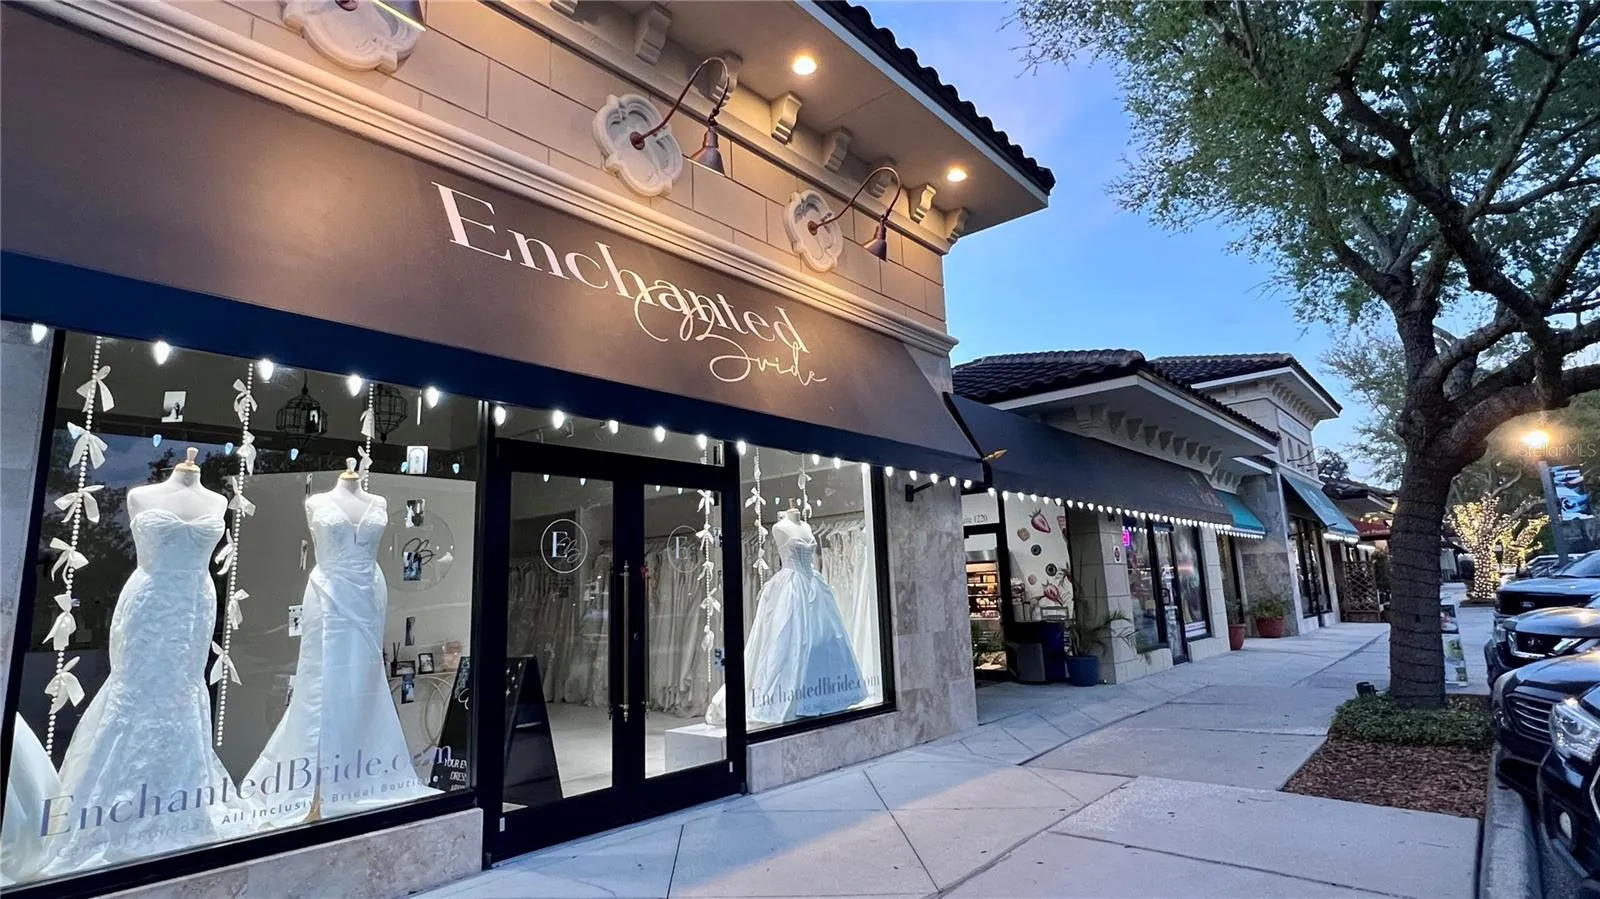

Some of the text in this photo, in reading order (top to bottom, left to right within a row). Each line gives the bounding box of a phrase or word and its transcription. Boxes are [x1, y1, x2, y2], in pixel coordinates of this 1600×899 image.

[431, 181, 810, 353] Enchanted
[634, 284, 827, 386] Bride
[973, 514, 988, 523] 1220
[752, 674, 880, 708] EnchantedBride.com
[40, 745, 452, 838] EnchantedBride.com
[222, 811, 245, 825] All
[253, 797, 325, 819] Inclusive
[331, 786, 375, 803] Bridal
